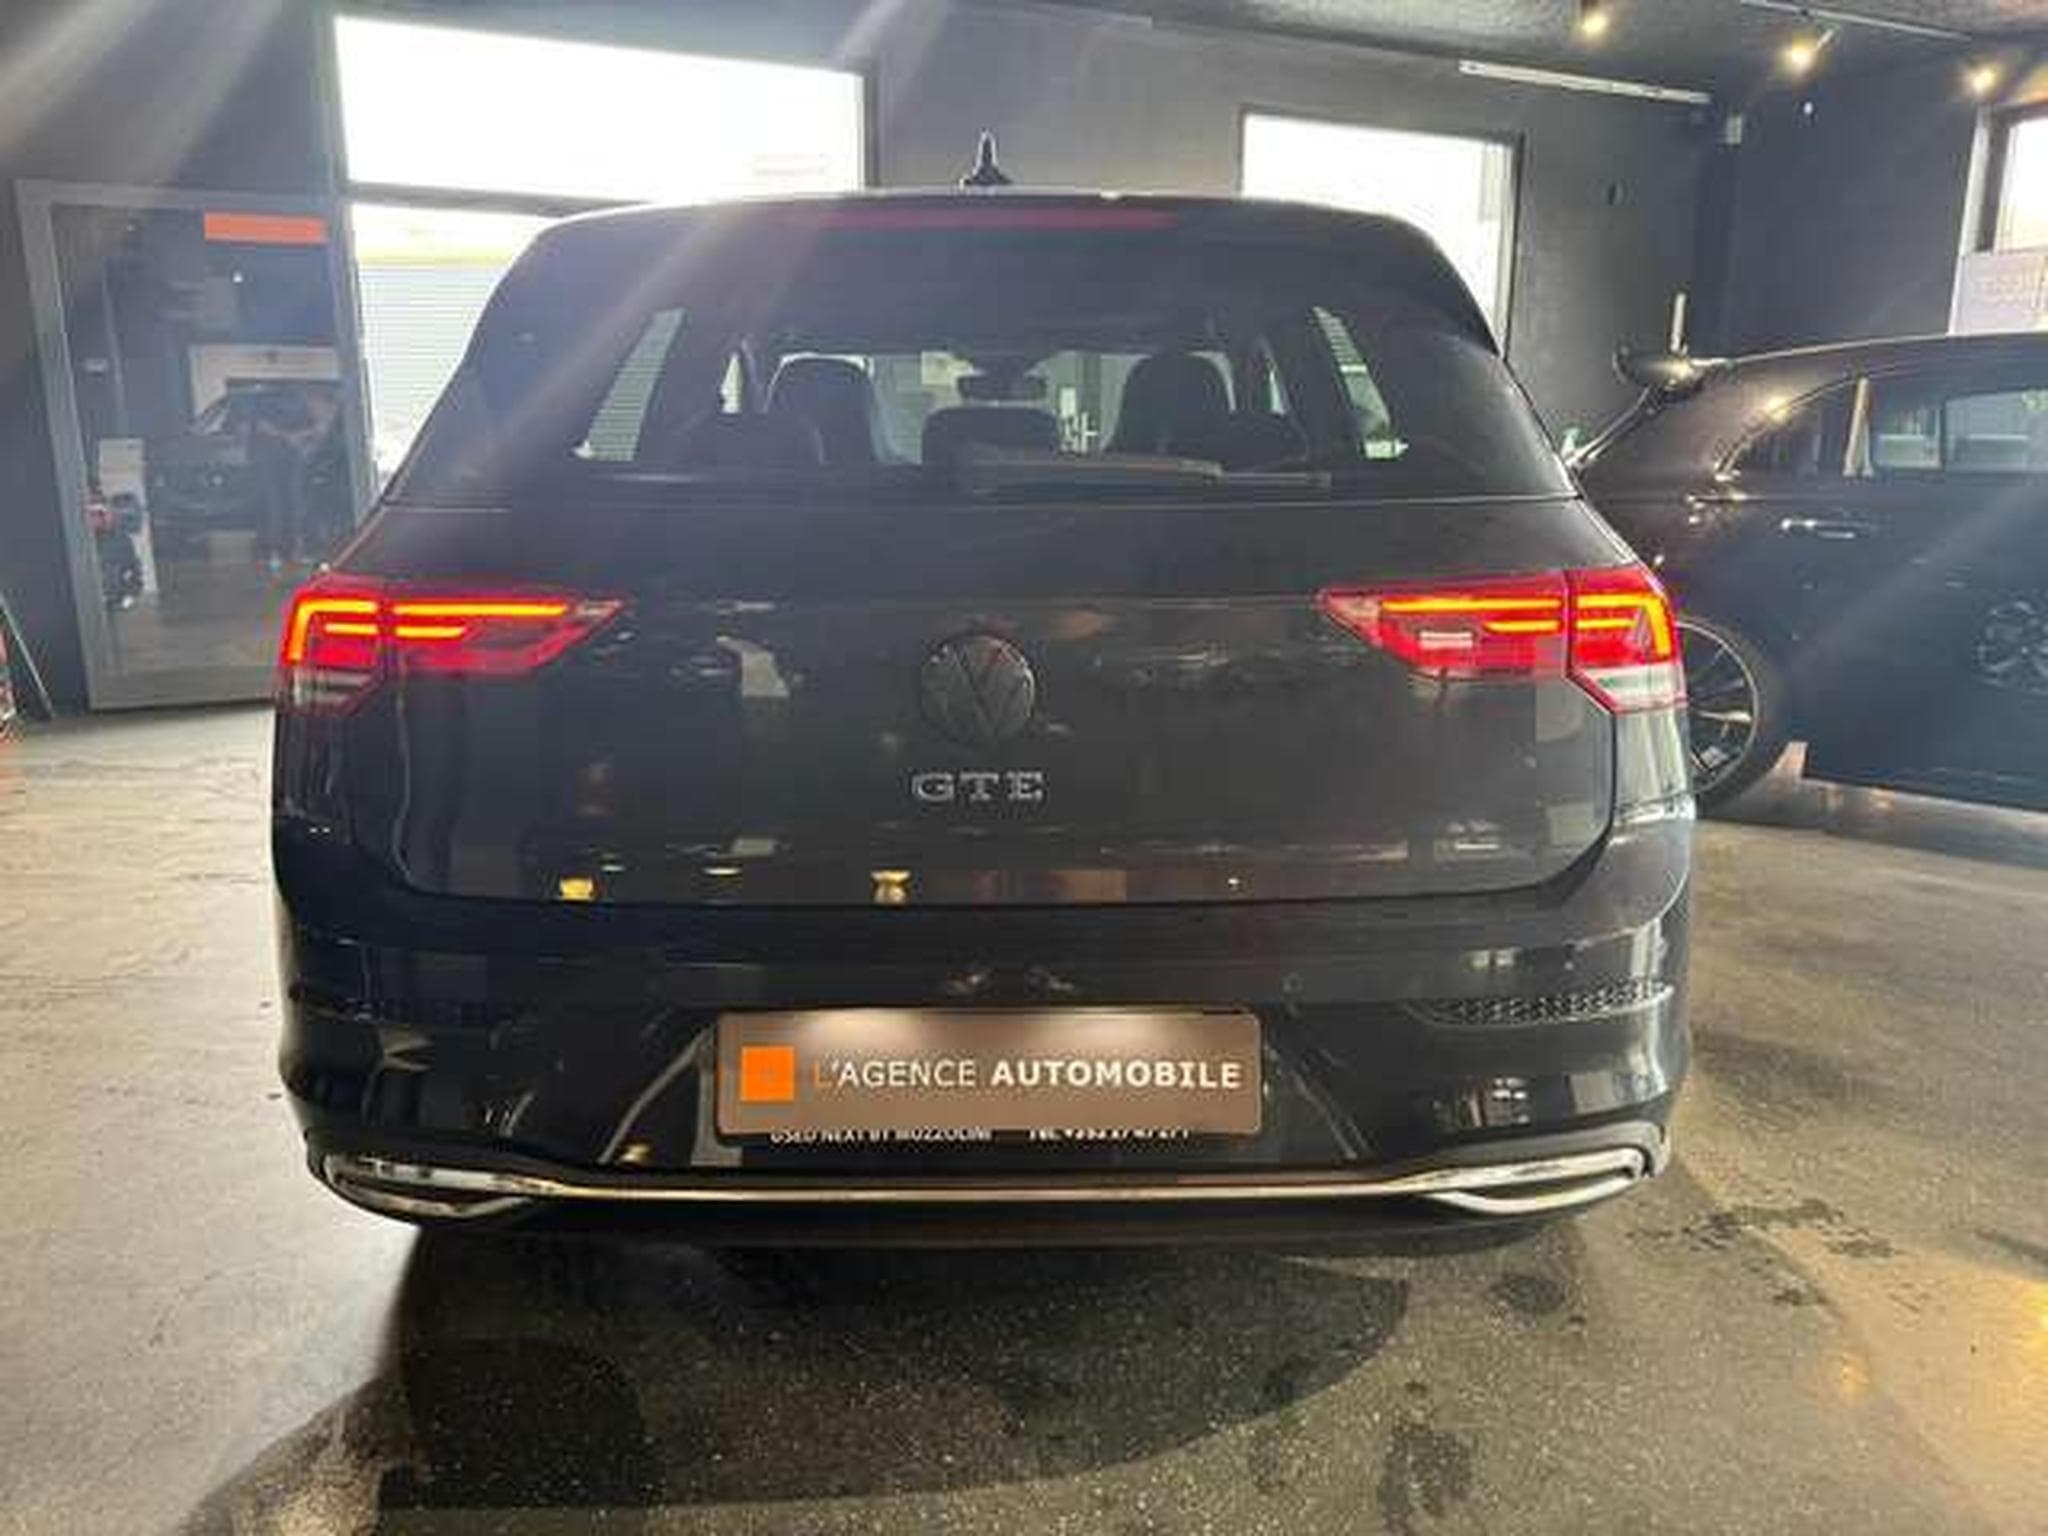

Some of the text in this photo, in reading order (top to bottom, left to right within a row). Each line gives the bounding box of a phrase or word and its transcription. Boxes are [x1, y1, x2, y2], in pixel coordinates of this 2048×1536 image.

[912, 771, 1044, 801] GTE
[814, 1060, 1242, 1089] L'AGENCE AUTOMOBILE
